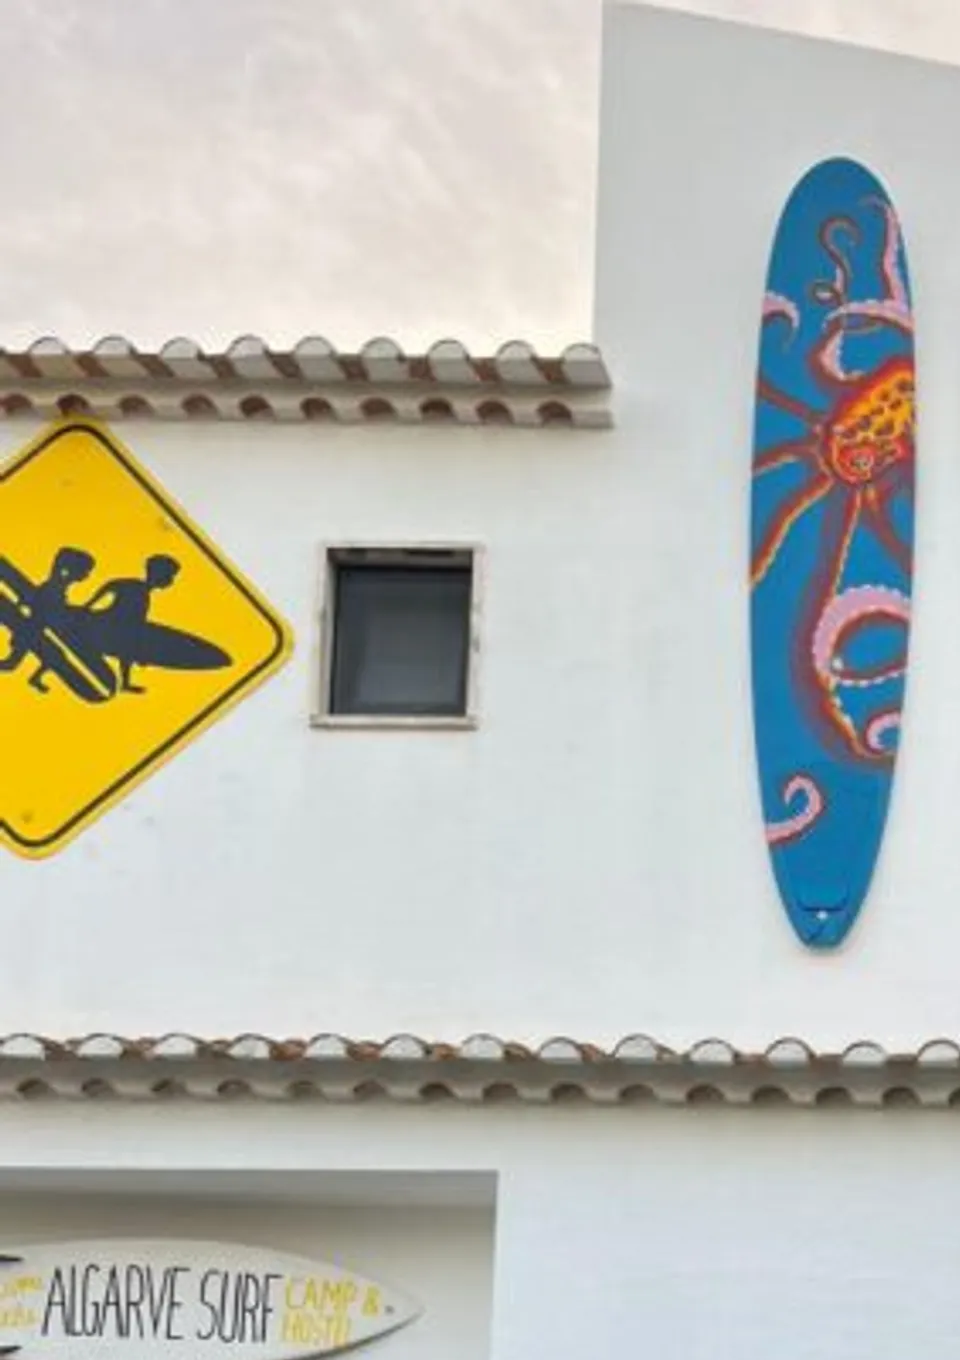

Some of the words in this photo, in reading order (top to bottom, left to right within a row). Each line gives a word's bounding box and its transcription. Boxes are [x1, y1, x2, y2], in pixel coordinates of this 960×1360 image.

[41, 1264, 191, 1340] ALGARVE
[197, 1268, 283, 1344] SURF
[285, 1276, 359, 1311] CAMP
